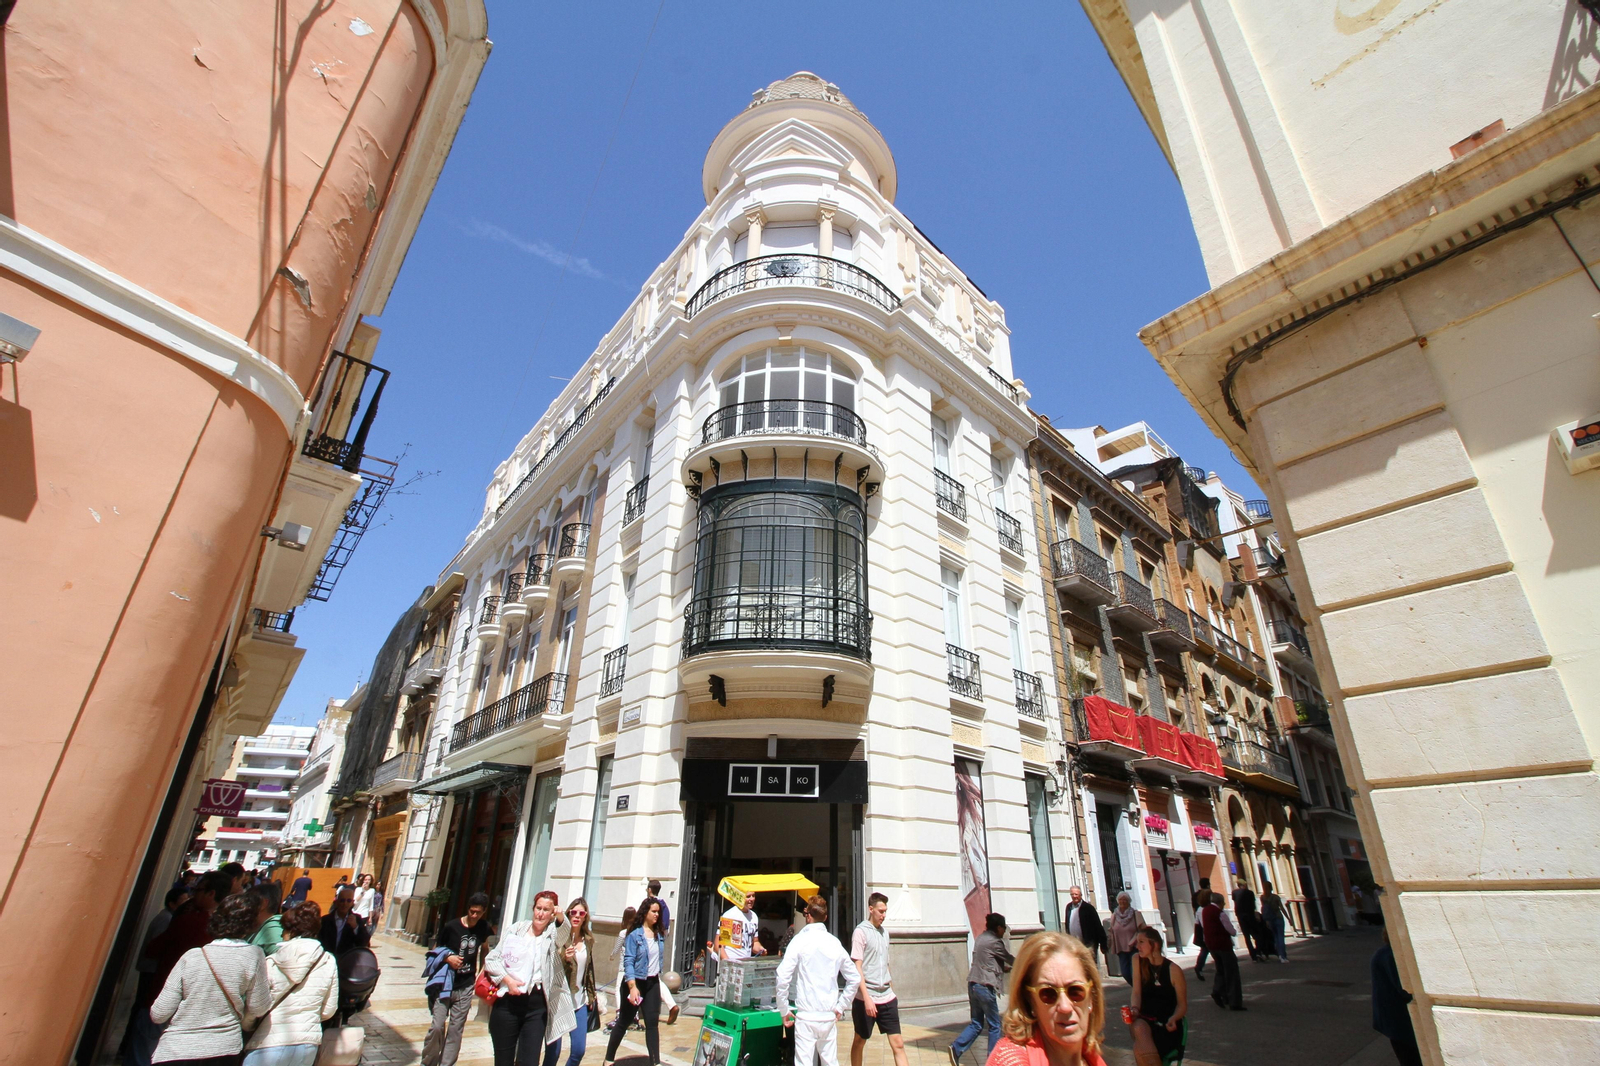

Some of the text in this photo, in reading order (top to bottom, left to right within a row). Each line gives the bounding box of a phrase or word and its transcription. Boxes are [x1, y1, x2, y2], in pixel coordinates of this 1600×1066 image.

[740, 776, 809, 785] MI SA KO
[200, 807, 237, 815] DENTIX
